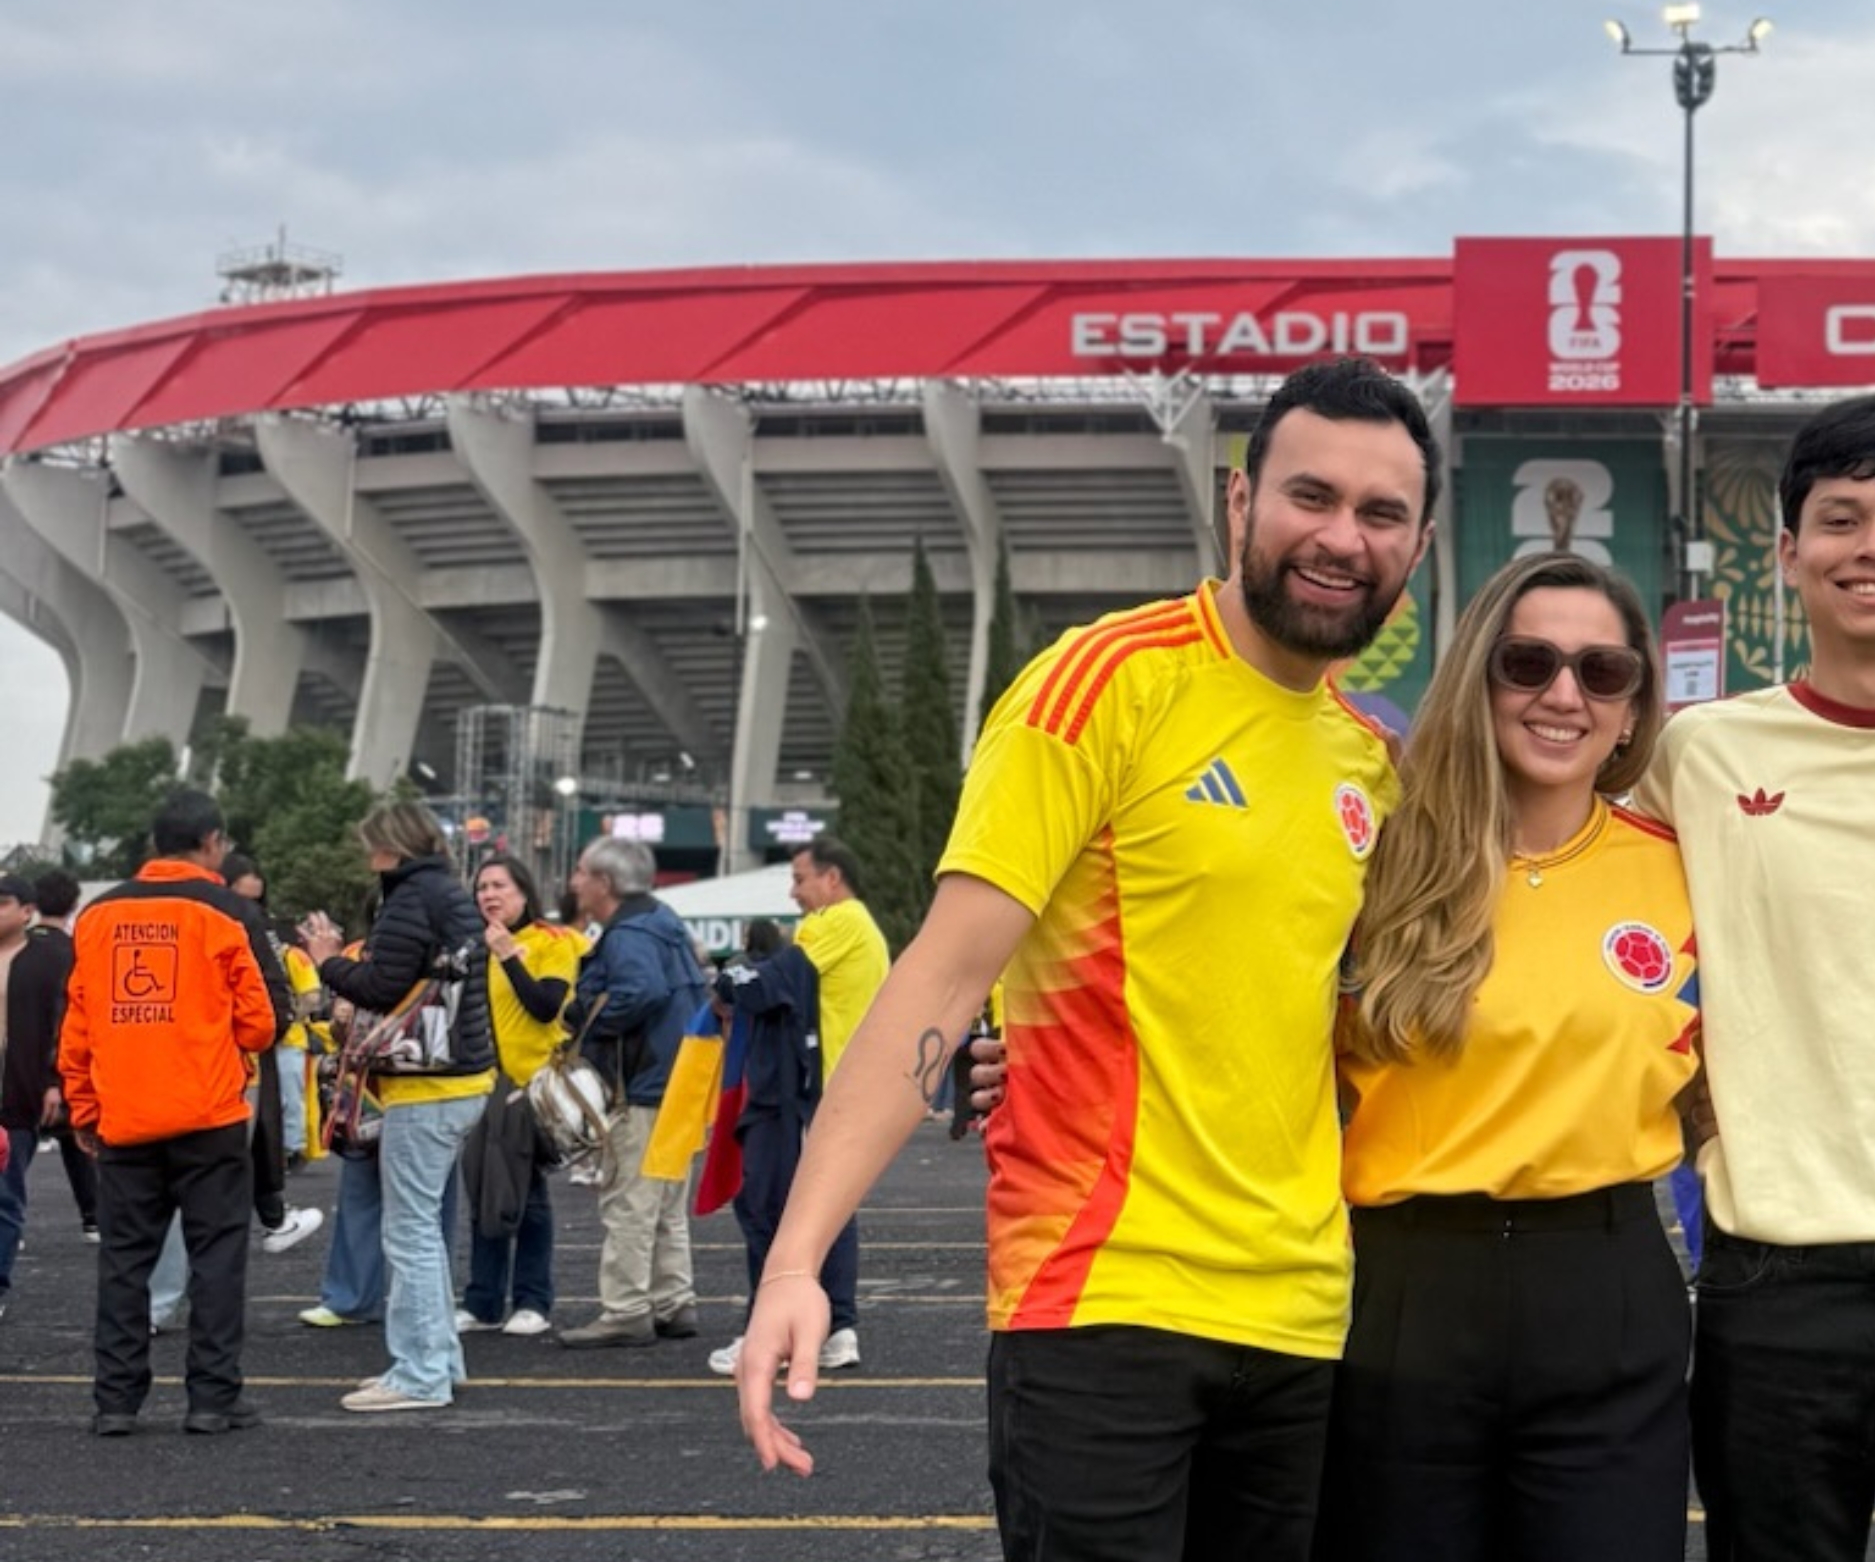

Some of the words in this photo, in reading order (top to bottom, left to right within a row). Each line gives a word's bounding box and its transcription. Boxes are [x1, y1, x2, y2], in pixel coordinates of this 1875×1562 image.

[1071, 312, 1408, 356] ESTADIO
[1548, 375, 1621, 391] 2026
[114, 923, 179, 940] ATENCION
[112, 1005, 175, 1023] ESPECIAL
